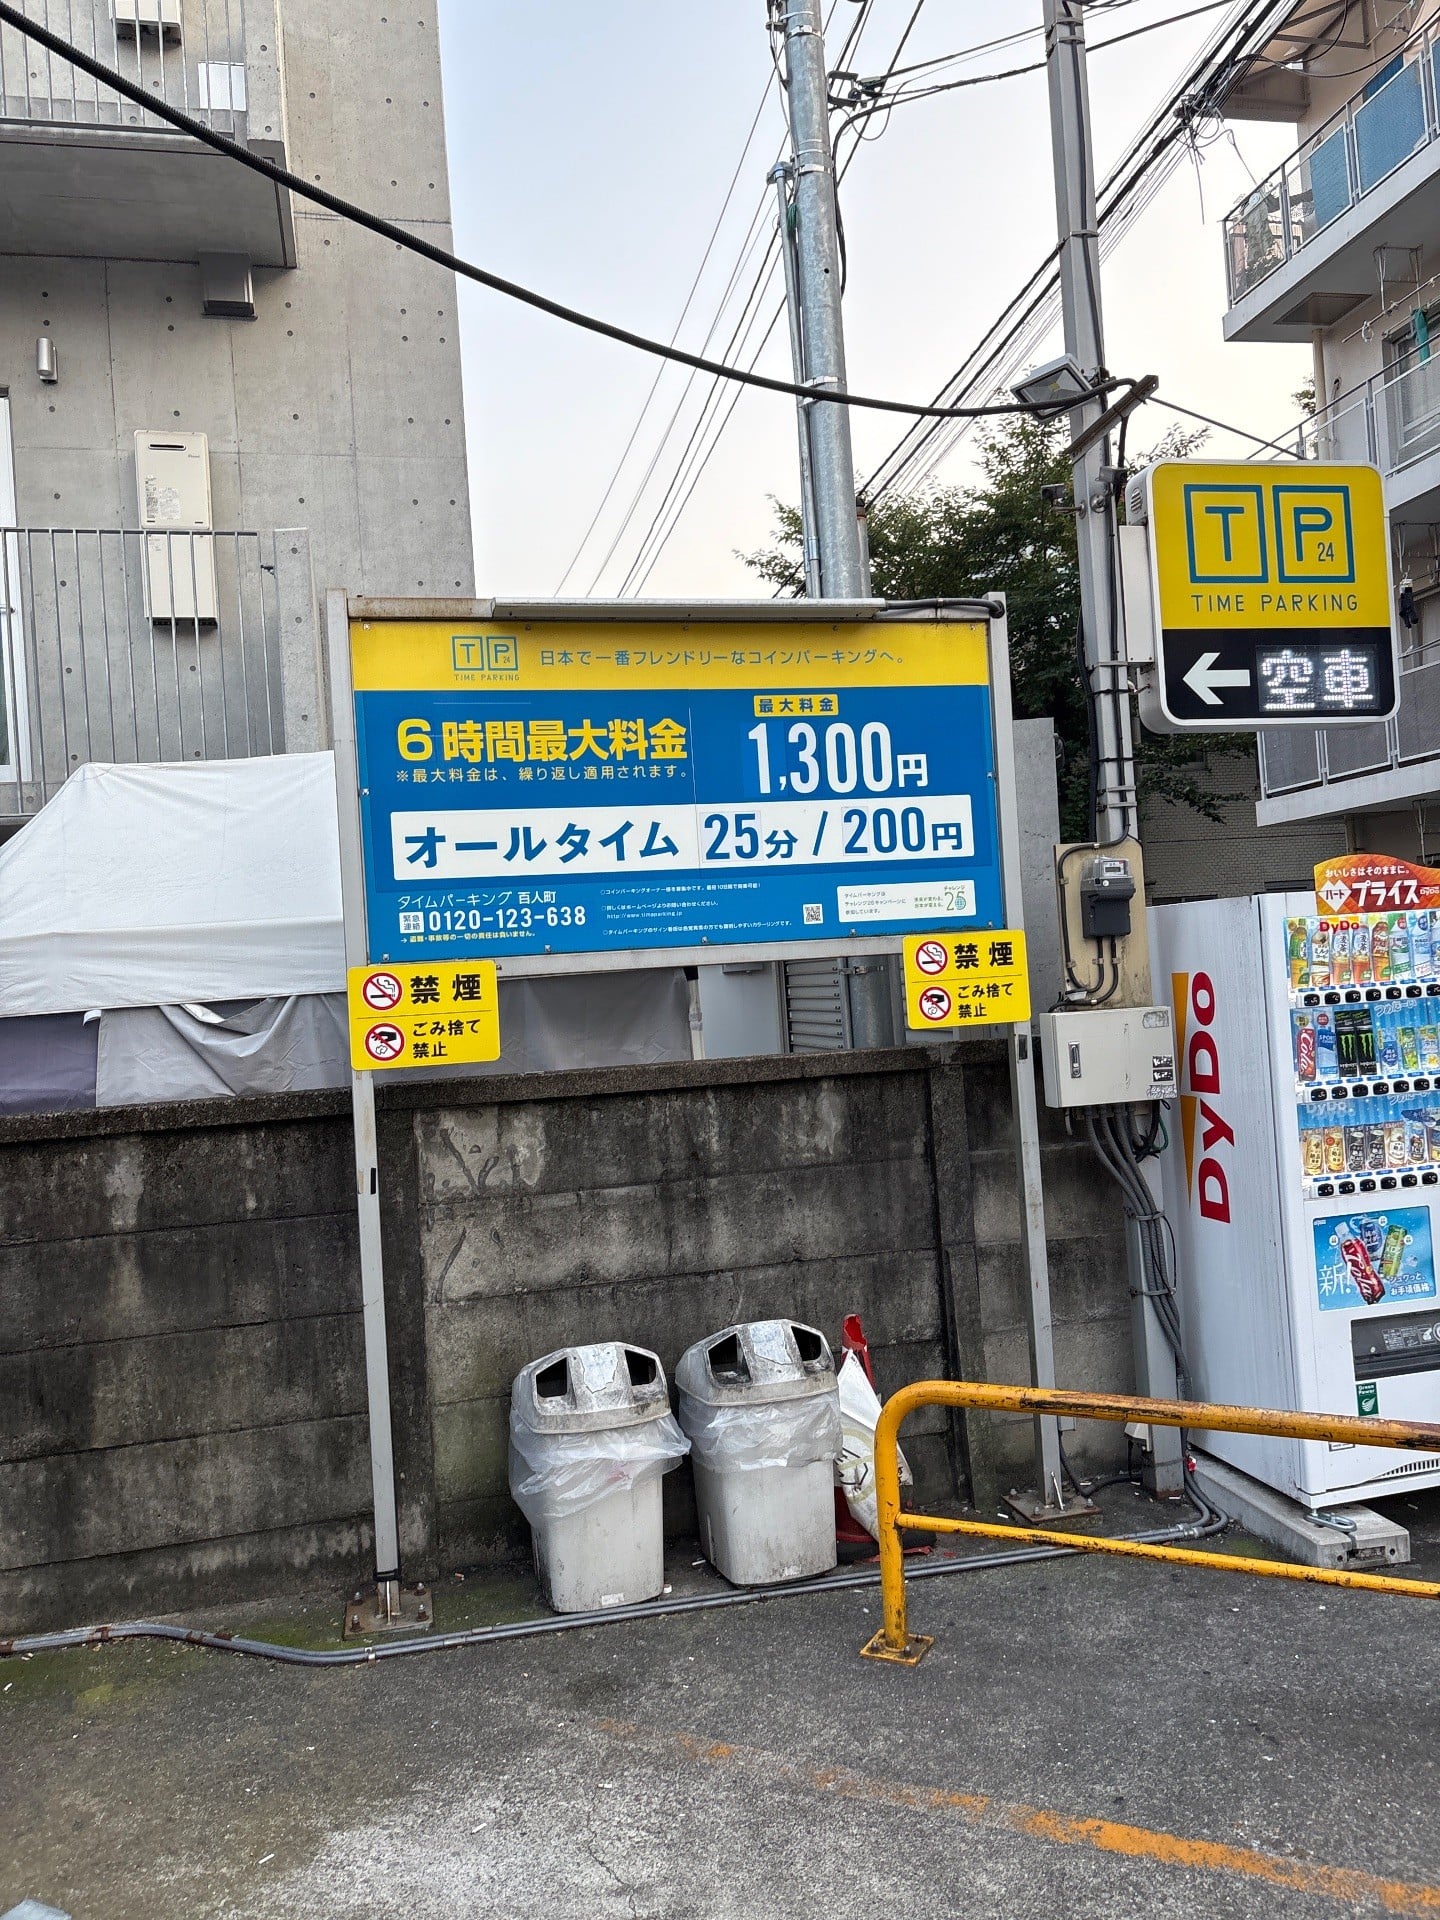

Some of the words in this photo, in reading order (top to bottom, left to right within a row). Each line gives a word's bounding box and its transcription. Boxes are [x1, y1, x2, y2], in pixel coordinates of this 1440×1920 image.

[1317, 542, 1334, 562] 24
[1191, 594, 1244, 612] TIME
[1260, 594, 1358, 612] PARKING
[541, 648, 903, 666] 日本で一番フレンドリーなコインパーキングへ。
[1262, 649, 1374, 709] 空車
[759, 697, 834, 713] 最大料金
[397, 718, 688, 763] 6時間最大料金
[748, 721, 928, 794] 1,300円
[404, 820, 680, 868] オールタイム
[704, 813, 798, 860] 25分
[843, 806, 962, 854] 200円
[1352, 879, 1420, 907] プライス
[428, 906, 586, 931] 0120-123-638
[1319, 920, 1360, 934] DyDo
[954, 941, 1014, 969] 禁煙
[410, 974, 482, 1004] 禁煙
[958, 982, 1014, 999] ごみ捨て
[958, 1003, 987, 1018] 禁止
[413, 1019, 481, 1037] ごみ捨て
[413, 1041, 448, 1059] 禁止
